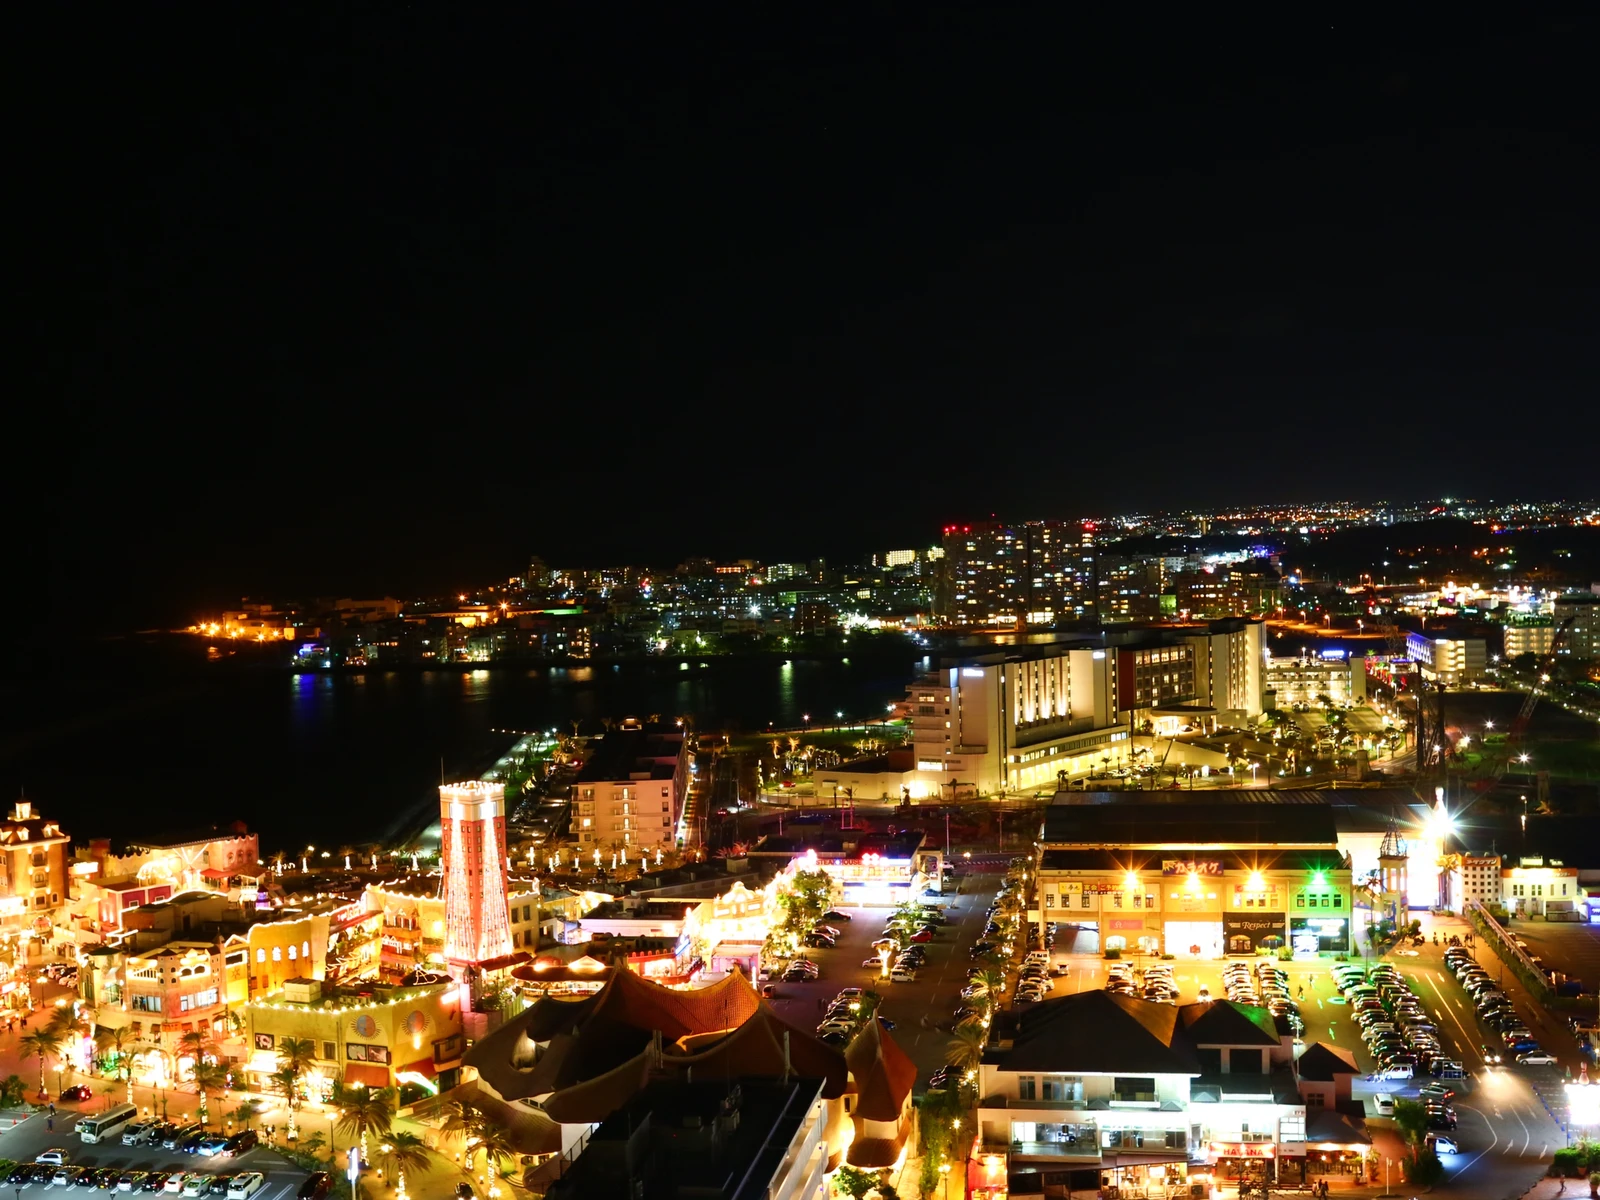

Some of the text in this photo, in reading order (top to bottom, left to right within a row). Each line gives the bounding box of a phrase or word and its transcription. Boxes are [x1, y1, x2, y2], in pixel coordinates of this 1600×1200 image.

[1175, 862, 1219, 874] カラオケ
[1242, 921, 1271, 931] Respect
